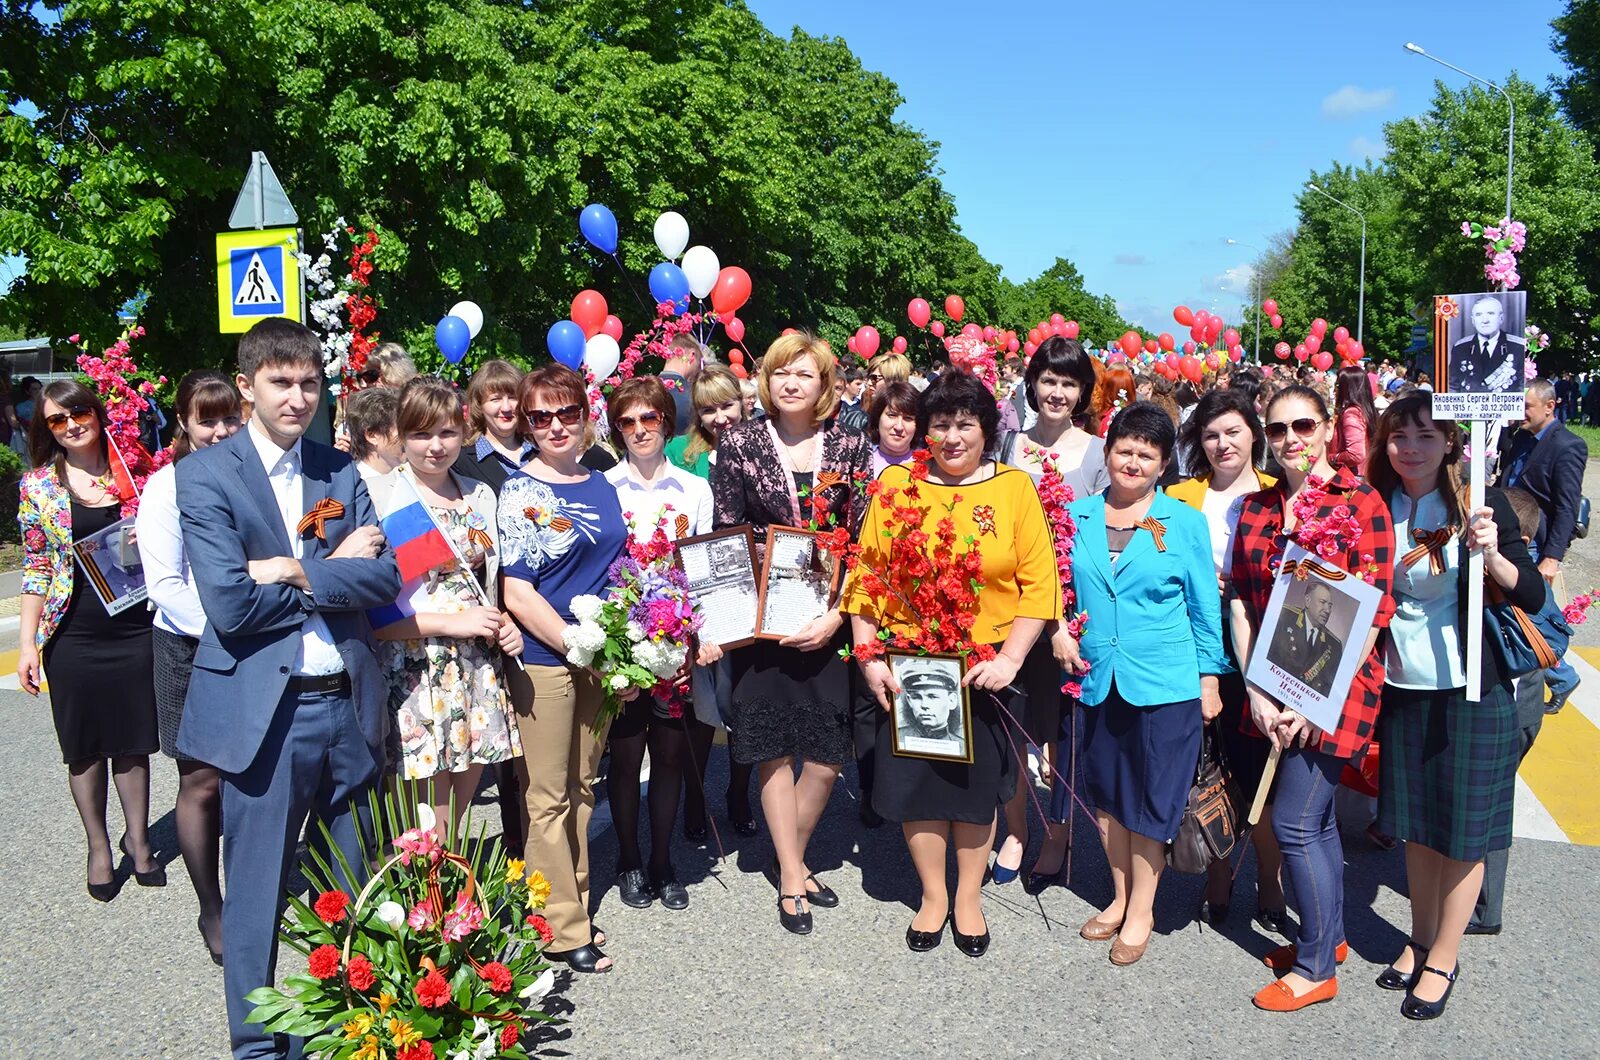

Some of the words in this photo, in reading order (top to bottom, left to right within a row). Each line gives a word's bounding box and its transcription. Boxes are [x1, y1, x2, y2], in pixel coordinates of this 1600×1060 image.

[1434, 395, 1465, 403] Яковенко
[1467, 394, 1490, 404] Сергей
[1491, 394, 1524, 404] Петрович
[1435, 404, 1466, 412] 10.10.1915
[1480, 404, 1515, 412] 30.12.2001
[1269, 665, 1320, 702] Колесников
[1279, 681, 1302, 700] Иван
